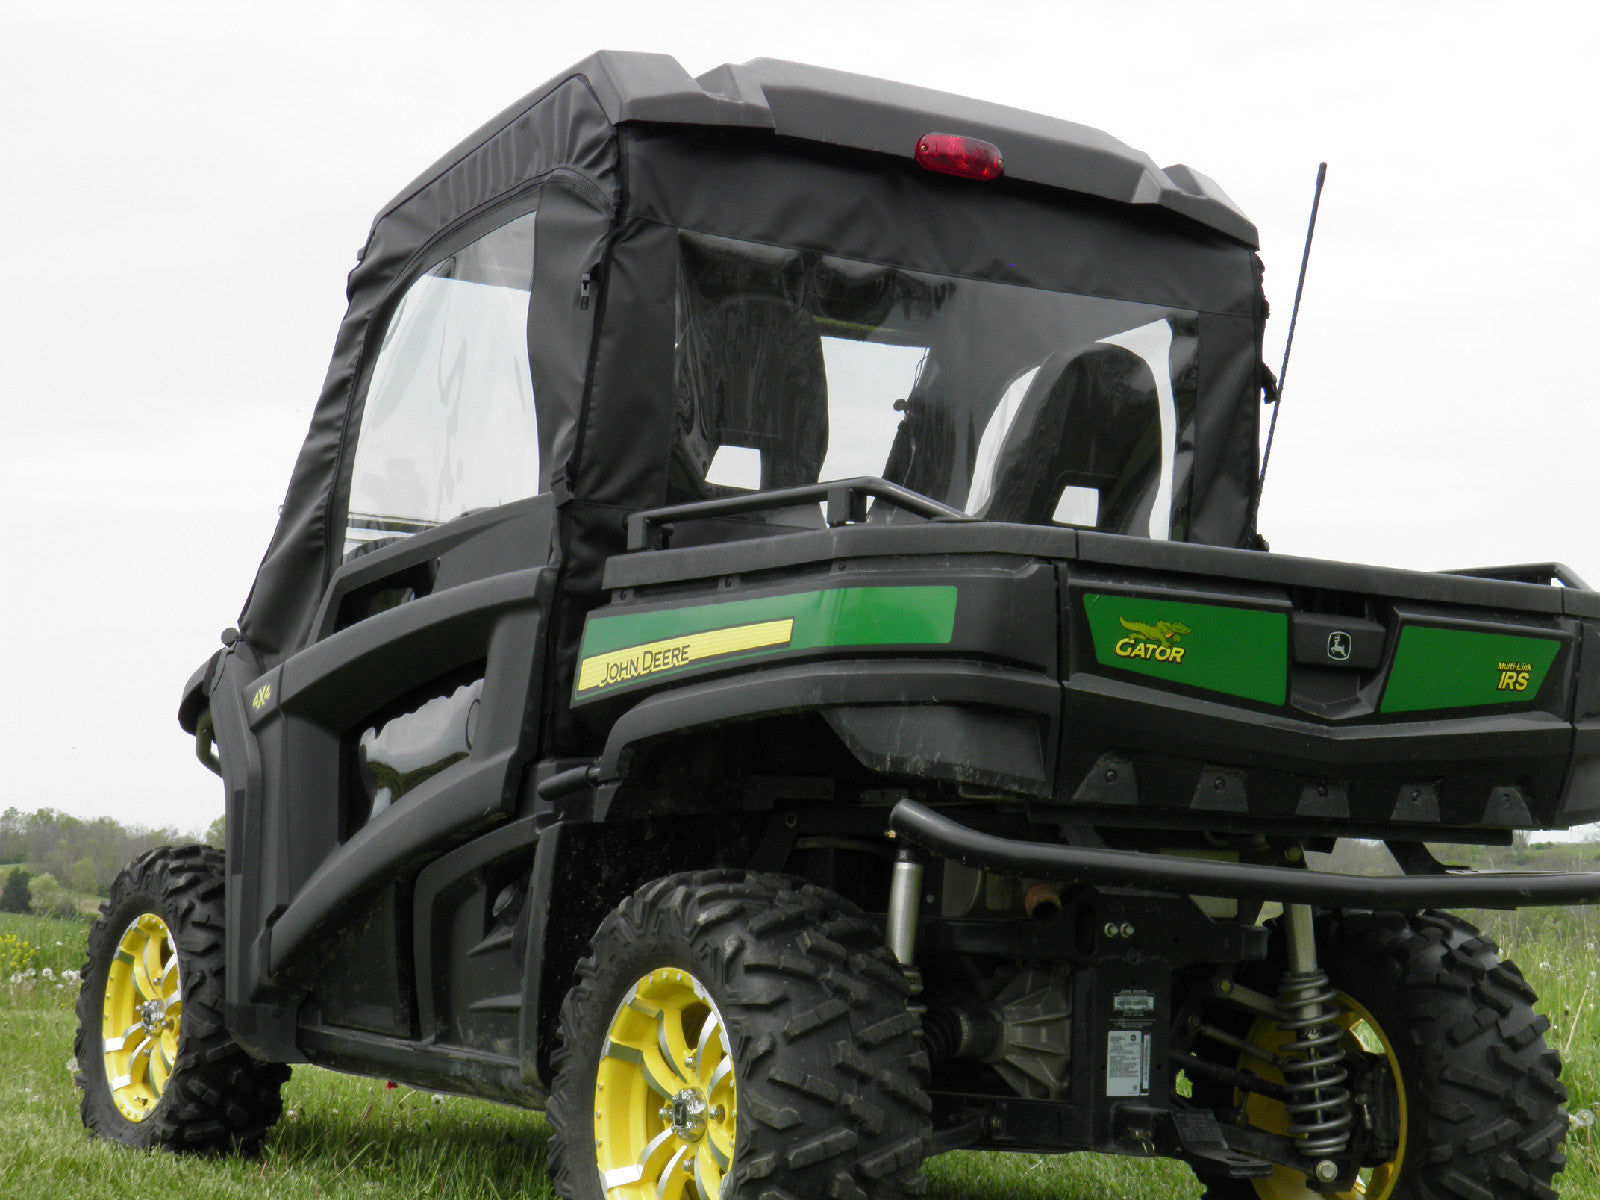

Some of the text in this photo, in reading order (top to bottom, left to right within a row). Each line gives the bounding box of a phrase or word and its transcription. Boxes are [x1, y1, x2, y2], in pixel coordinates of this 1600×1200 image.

[1115, 637, 1185, 663] GATOR
[600, 643, 691, 684] JOHN DEERE
[1498, 671, 1530, 691] IRS
